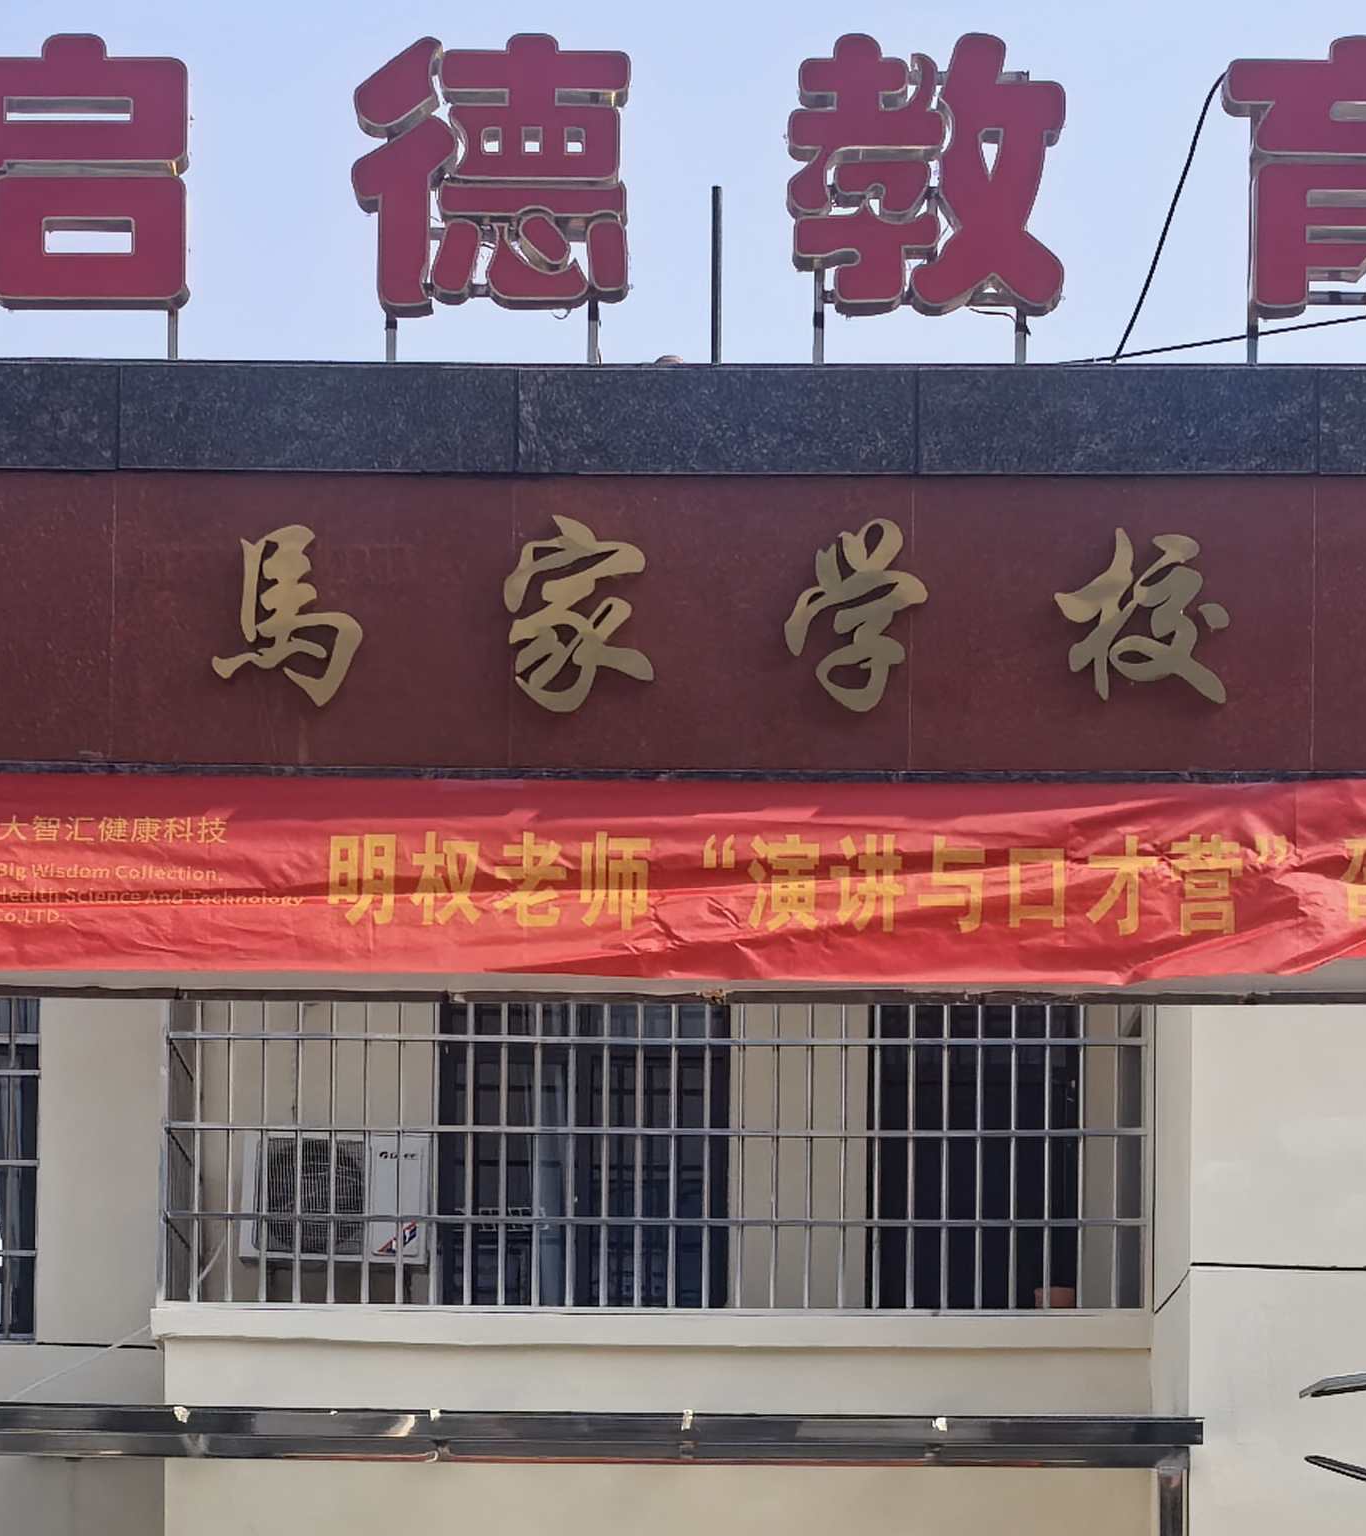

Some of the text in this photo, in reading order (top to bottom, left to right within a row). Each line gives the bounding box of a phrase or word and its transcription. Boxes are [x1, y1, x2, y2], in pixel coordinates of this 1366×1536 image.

[211, 514, 1230, 714] 馬家学校
[32, 862, 111, 879] Wisdom
[64, 887, 142, 904] Science
[145, 889, 184, 905] And
[188, 890, 305, 906] Technology
